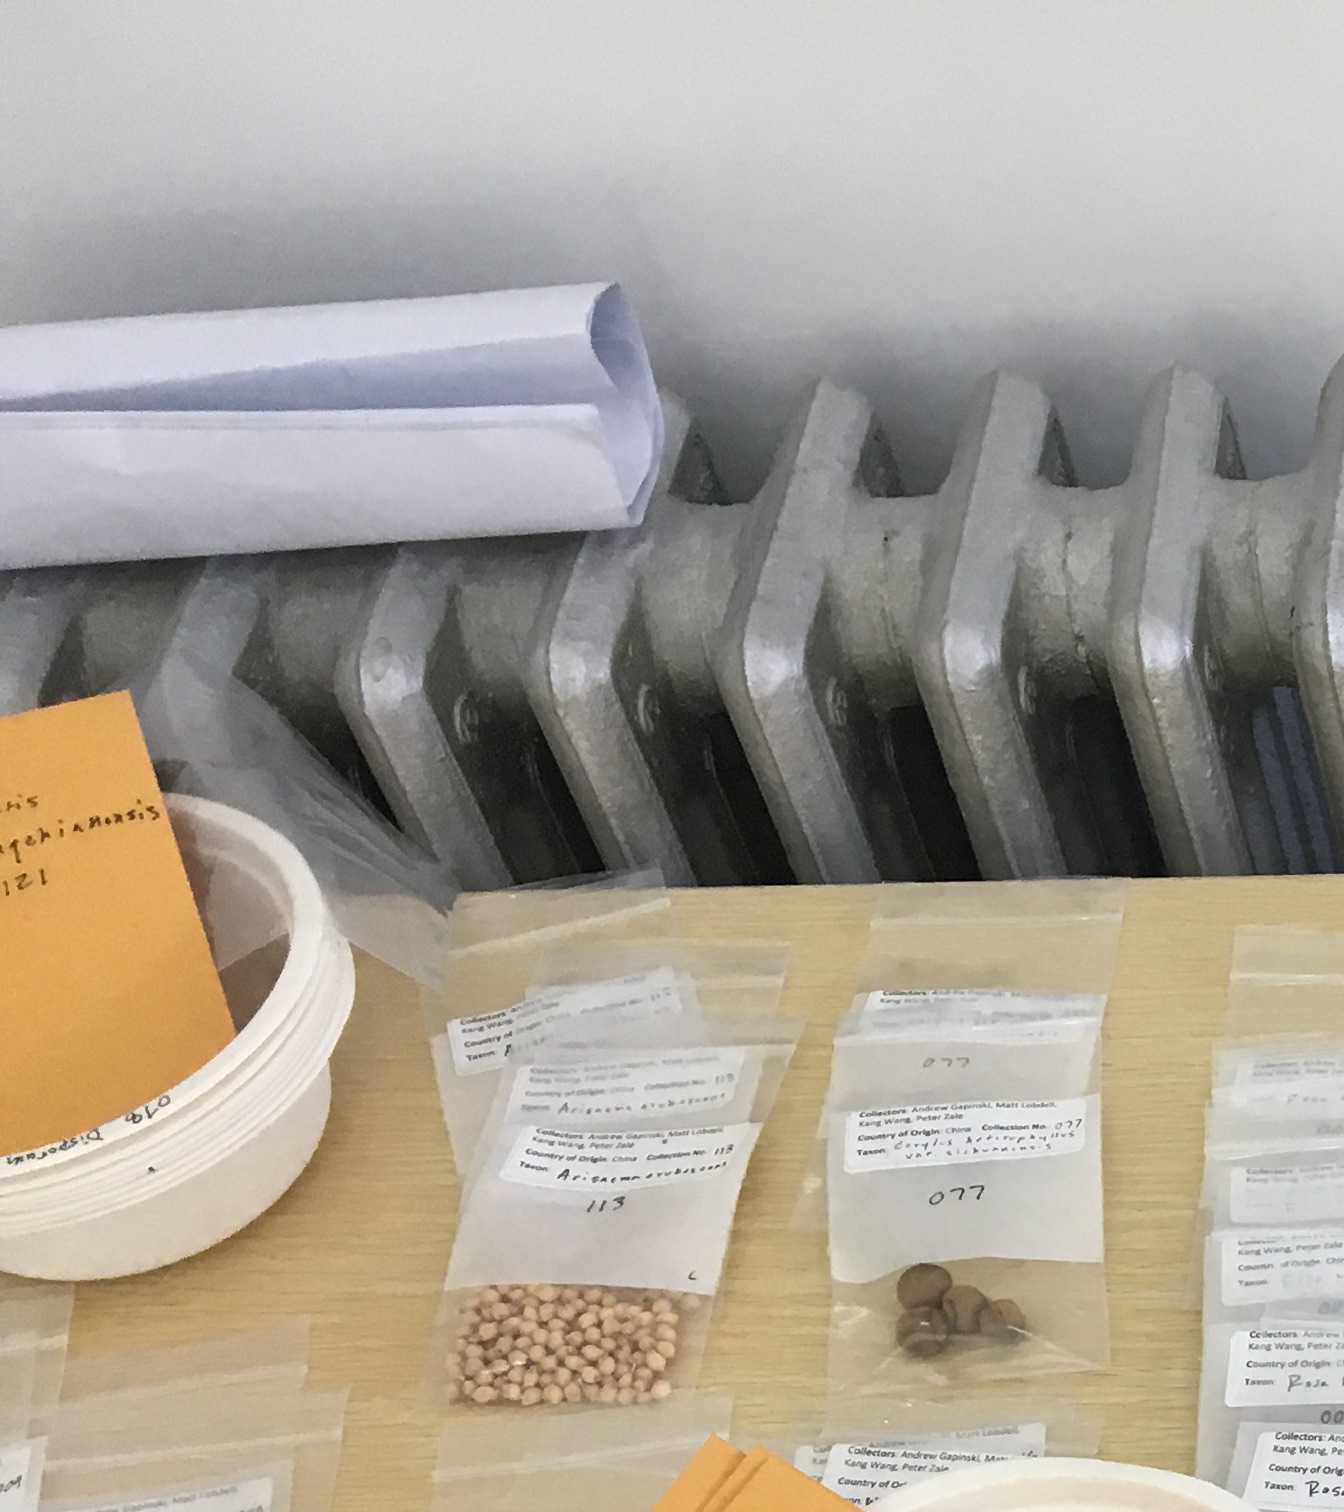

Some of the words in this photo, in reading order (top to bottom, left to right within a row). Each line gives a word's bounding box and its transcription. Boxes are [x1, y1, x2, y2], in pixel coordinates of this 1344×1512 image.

[2, 868, 47, 896] 121
[929, 1184, 985, 1206] 077
[586, 1195, 626, 1213] 113
[1274, 1431, 1325, 1442] Collectors:
[1272, 1445, 1296, 1455] Kang
[1268, 1463, 1308, 1475] Country
[1310, 1465, 1322, 1474] of
